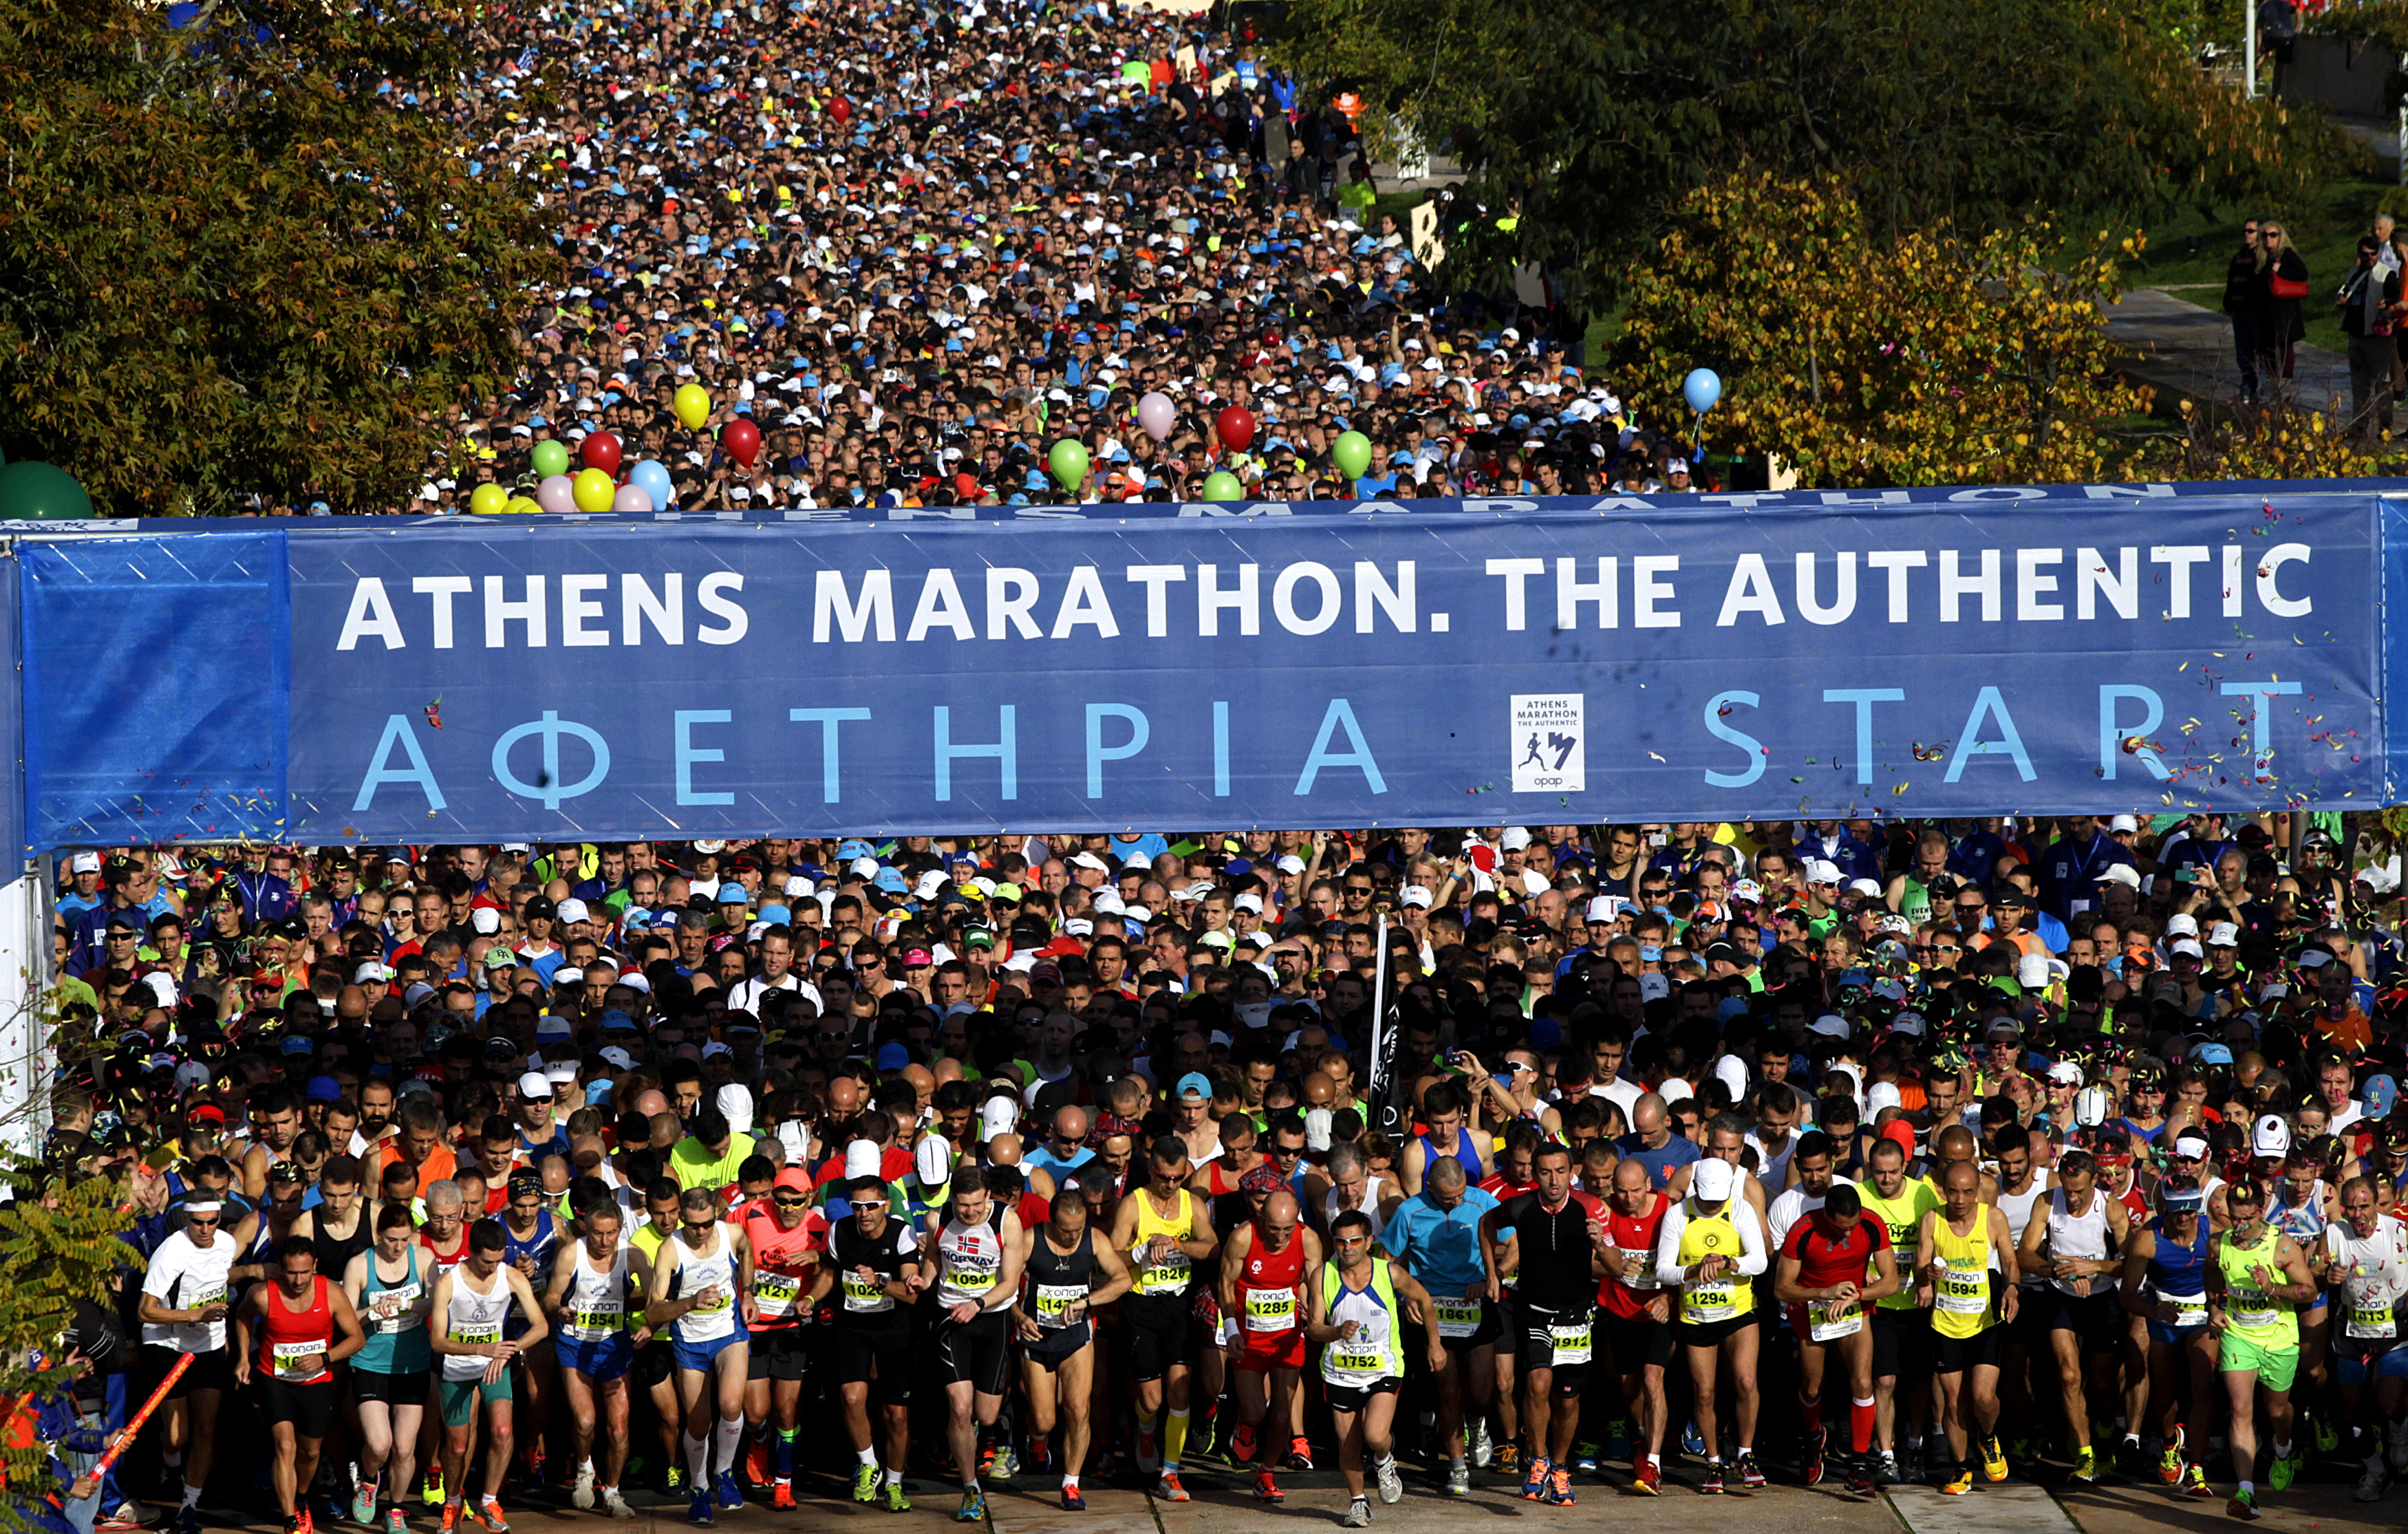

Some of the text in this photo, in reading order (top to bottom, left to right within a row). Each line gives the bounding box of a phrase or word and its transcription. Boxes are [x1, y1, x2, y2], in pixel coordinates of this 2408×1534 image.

[336, 542, 2312, 651] ATHENS MARATHON. THE AUTHENTIC
[1527, 700, 1568, 709] ATHENS
[1517, 710, 1578, 719] MARATHON
[1703, 681, 2303, 788] START
[352, 698, 1388, 811] ΑΦΕΤΗΡΙΑ
[1534, 777, 1562, 788] opap
[943, 1251, 995, 1266] NORWAY
[953, 1274, 988, 1285] 1090
[1150, 1268, 1185, 1282] 1826
[1944, 1282, 1977, 1295] 1594
[1691, 1292, 1728, 1305] 1294
[1254, 1301, 1289, 1314] 1285
[579, 1314, 616, 1326] 1854
[1438, 1308, 1472, 1320] 1861
[458, 1334, 492, 1343] 1853
[1554, 1337, 1588, 1348] 1912
[1341, 1356, 1377, 1367] 1752
